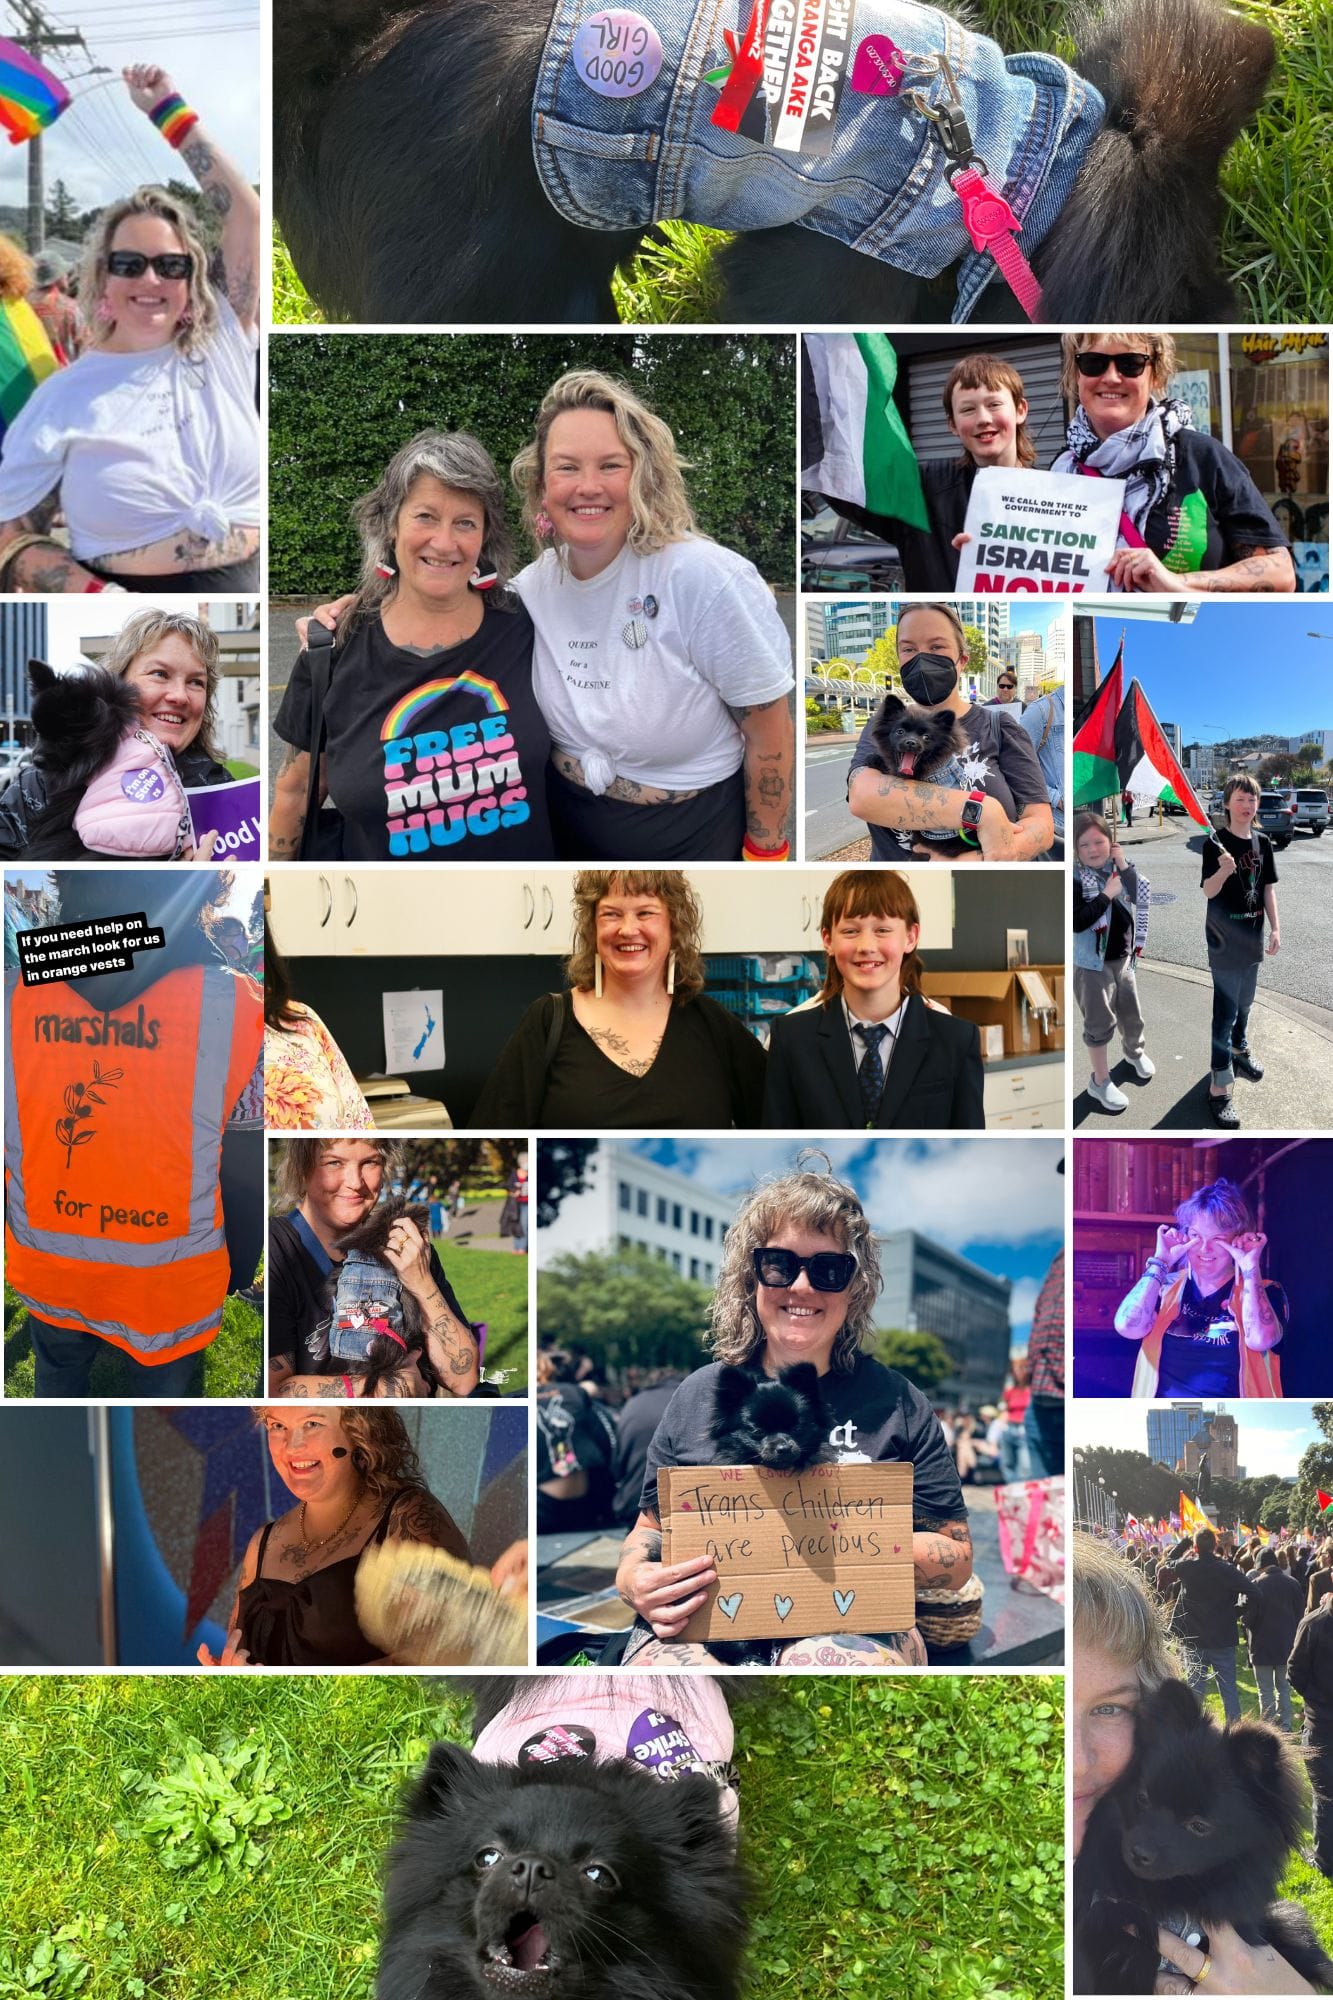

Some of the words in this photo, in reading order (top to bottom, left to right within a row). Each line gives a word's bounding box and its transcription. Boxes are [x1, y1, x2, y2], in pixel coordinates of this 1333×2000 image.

[590, 17, 648, 56] GIRL
[586, 56, 644, 88] GOOD
[811, 48, 844, 121] BACK
[786, 72, 808, 118] AKE
[1001, 495, 1015, 503] WE
[1017, 497, 1038, 506] CALL
[1040, 500, 1054, 508] ON
[1056, 502, 1073, 510] THE
[1004, 504, 1067, 516] GOVERNMENT
[980, 522, 1097, 550] SANCTION
[975, 543, 1090, 577] ISRAEL
[568, 640, 598, 650] QUEERS
[569, 660, 581, 669] for
[566, 674, 611, 690] PALESTINE
[383, 715, 515, 780] FREE
[135, 774, 158, 801] Strike
[138, 769, 150, 780] on
[384, 751, 522, 817] MUM
[386, 786, 531, 857] HUGS
[34, 1004, 160, 1050] marshals
[53, 1190, 93, 1218] for
[100, 1205, 169, 1233] peace
[719, 1469, 745, 1481] WE
[678, 1484, 765, 1526] Trans
[706, 1539, 752, 1563] are
[781, 1531, 881, 1567] precious
[633, 1729, 690, 1761] Strike
